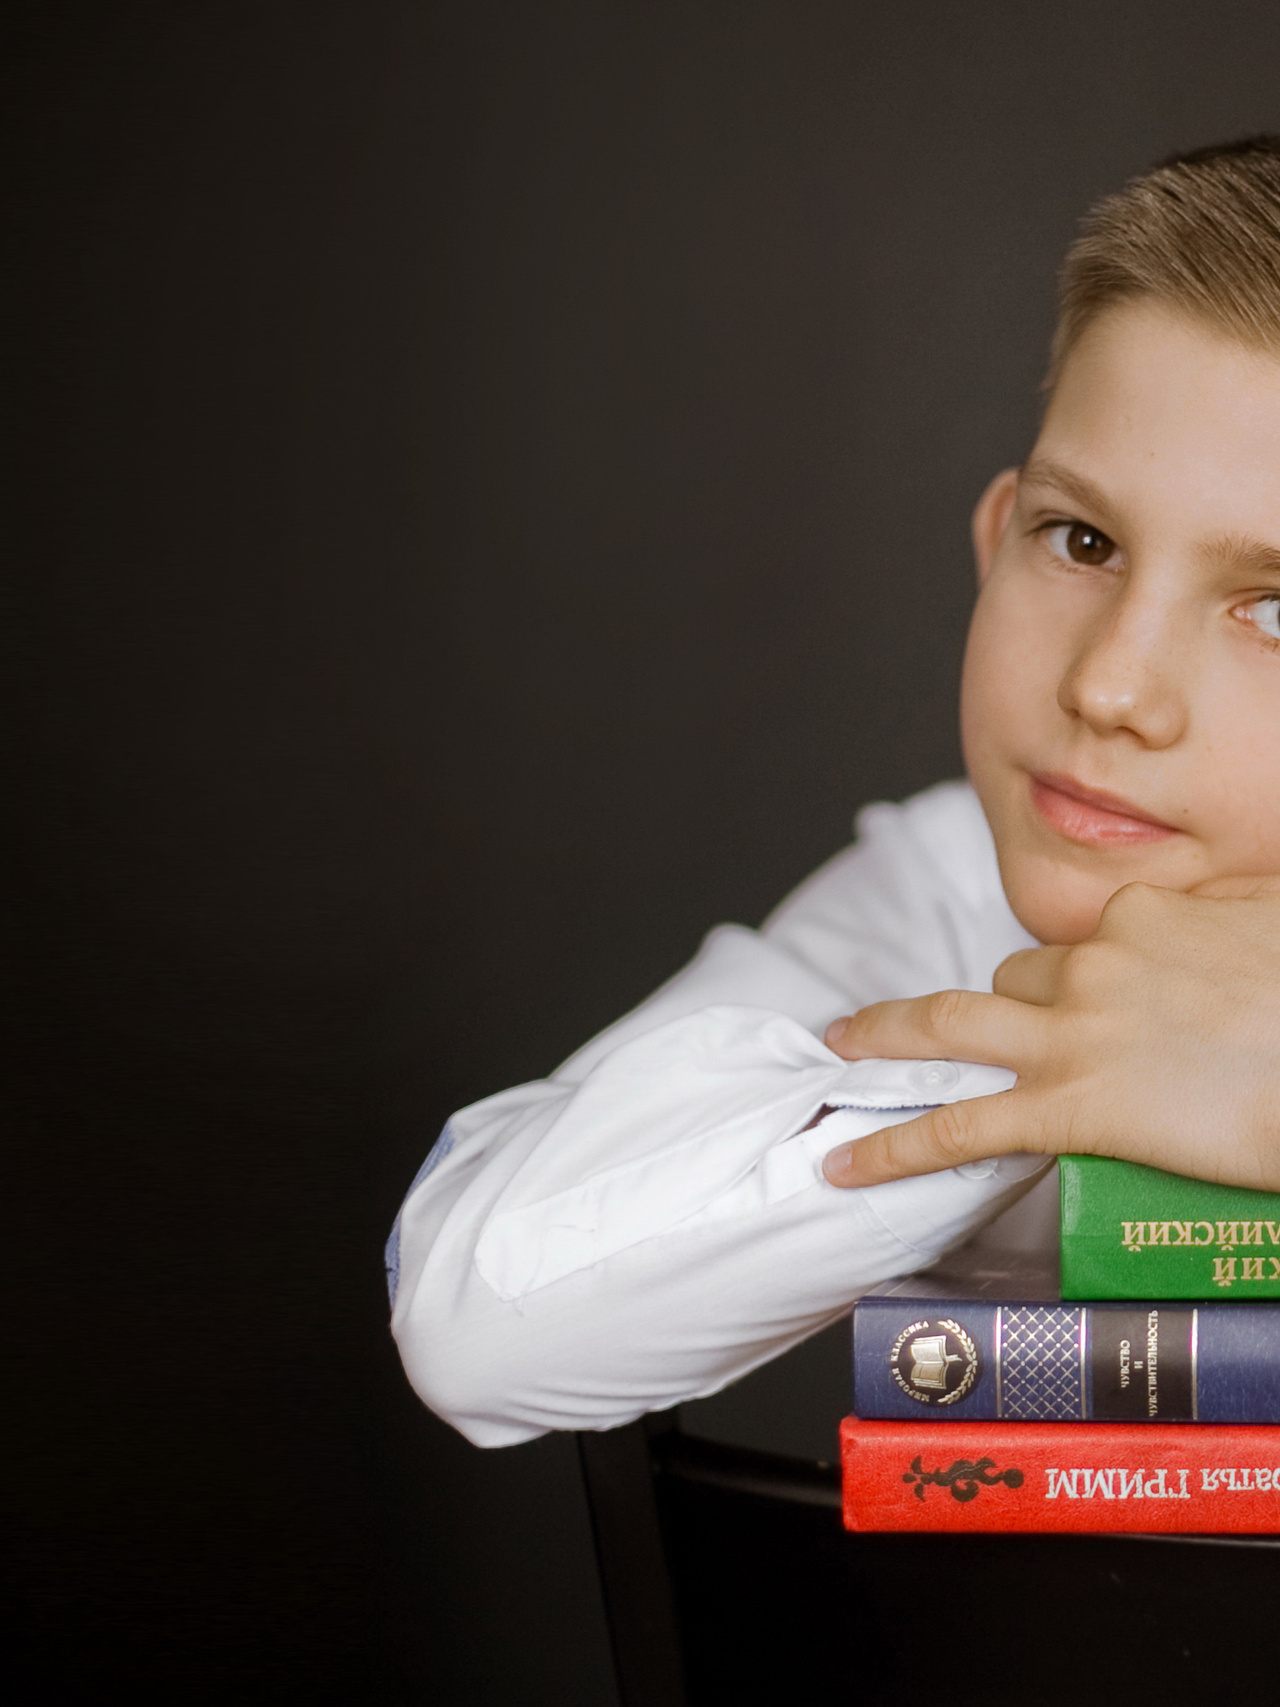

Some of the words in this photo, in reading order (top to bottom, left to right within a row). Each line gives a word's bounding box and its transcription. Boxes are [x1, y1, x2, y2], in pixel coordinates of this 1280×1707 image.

[890, 1320, 930, 1362] КЛАССИКА
[1120, 1339, 1130, 1388] ЧУВСТВО
[1133, 1360, 1143, 1369] И
[1147, 1310, 1159, 1417] ЧУВСТВИТЕЛЬНОСТЬ
[1045, 1467, 1191, 1500] ГРИММ
